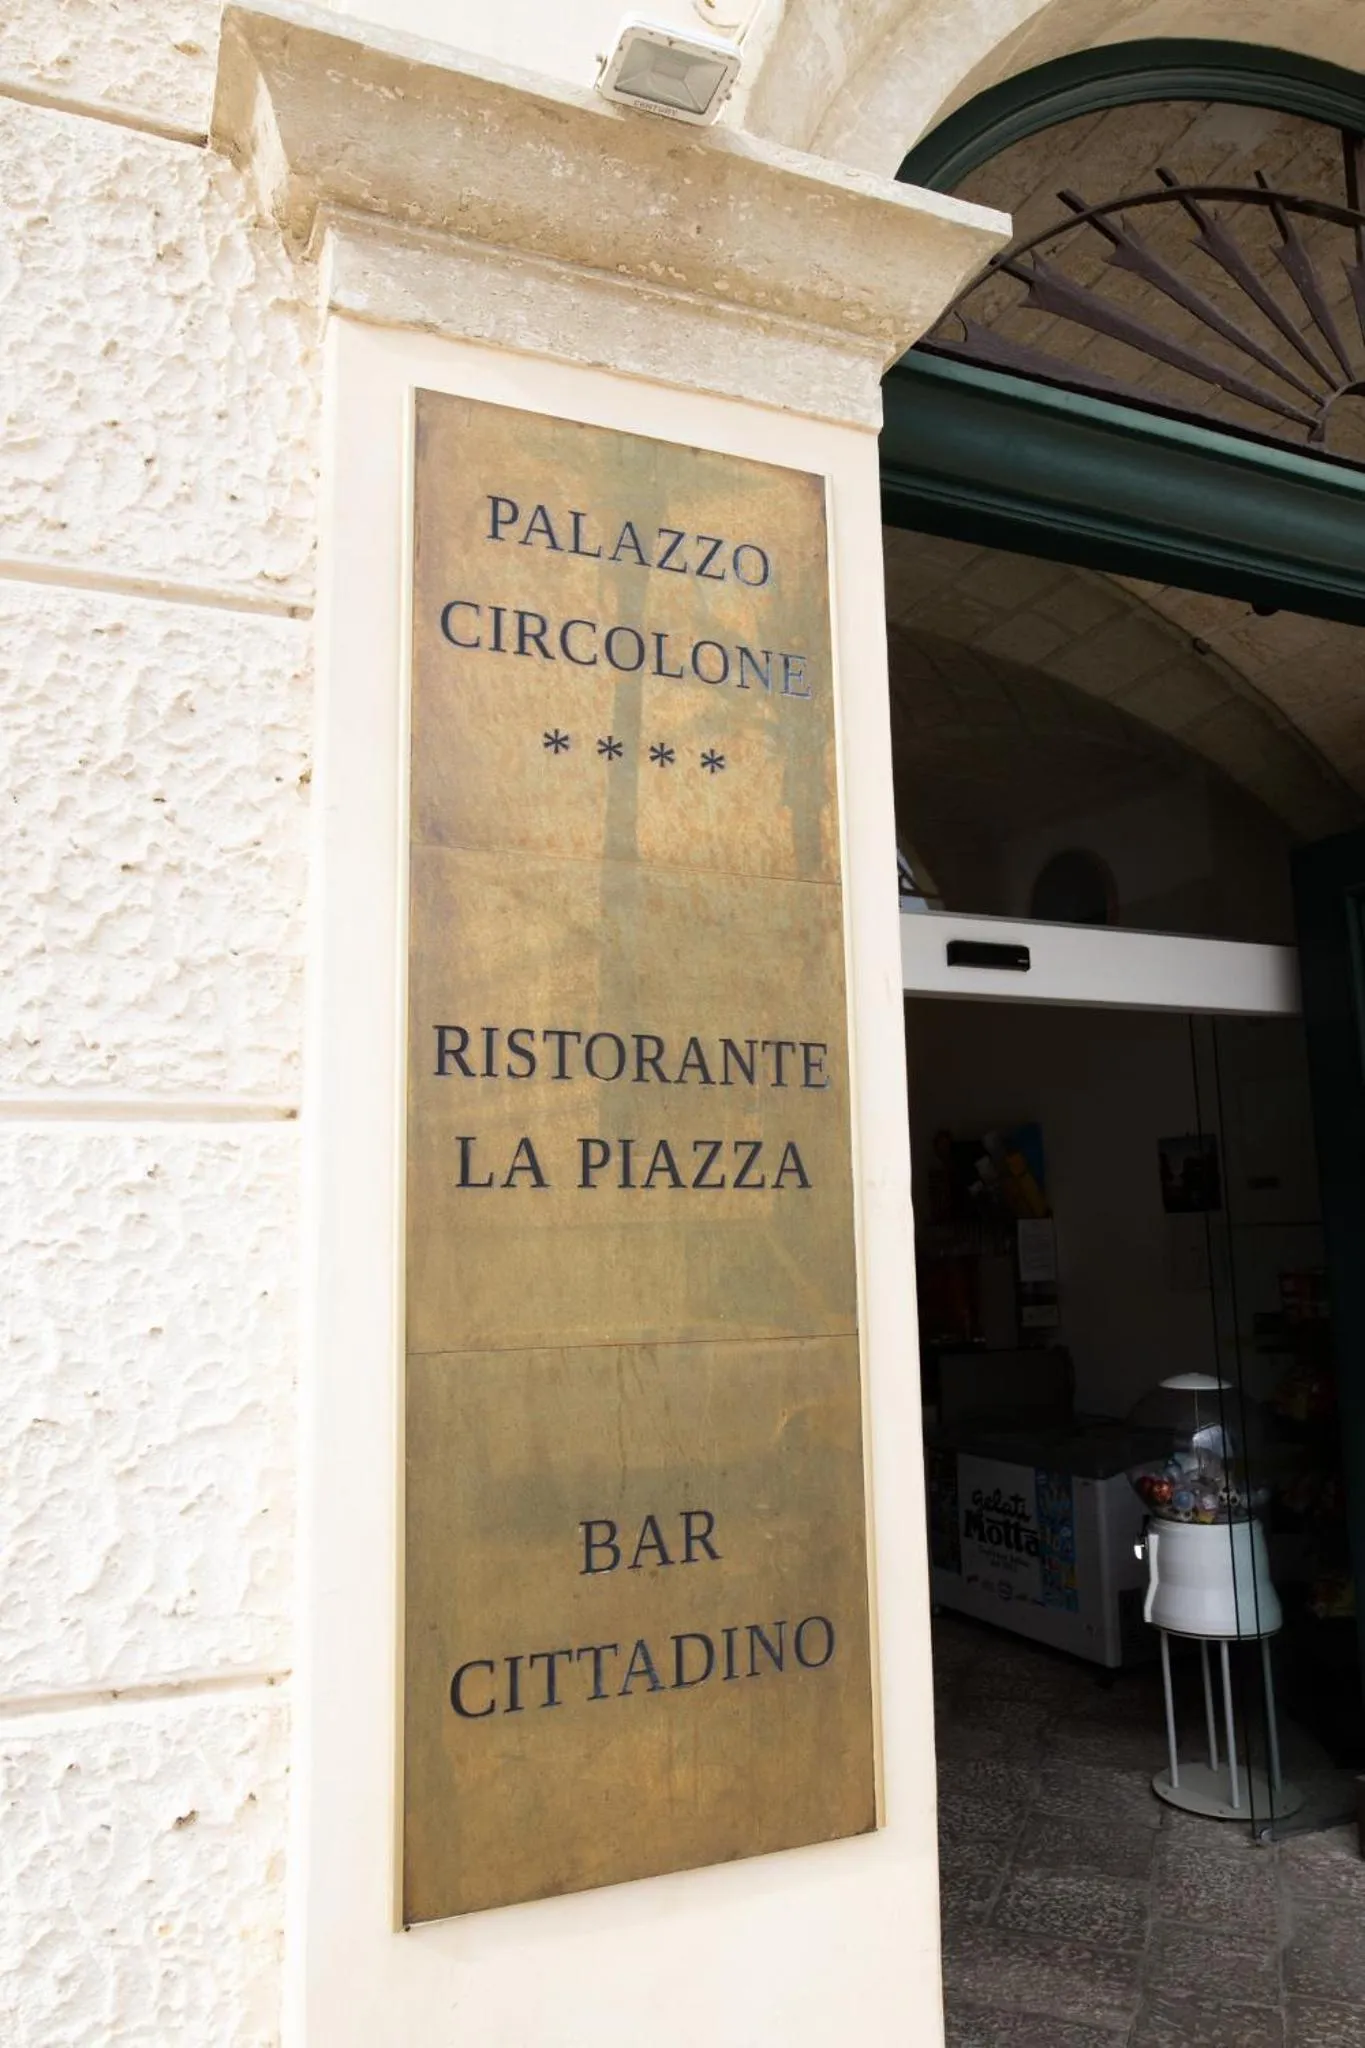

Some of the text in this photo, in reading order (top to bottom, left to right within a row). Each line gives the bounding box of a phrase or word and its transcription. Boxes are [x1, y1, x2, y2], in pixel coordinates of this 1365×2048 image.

[486, 495, 771, 587] PALAZZO
[440, 600, 812, 698] CIRCOLONE
[432, 1025, 829, 1088] RISTORANTE
[455, 1136, 812, 1189] LA PIAZZA
[579, 1510, 722, 1575] BAR
[963, 1509, 1040, 1557] Motta
[449, 1615, 835, 1719] CITTADINO
